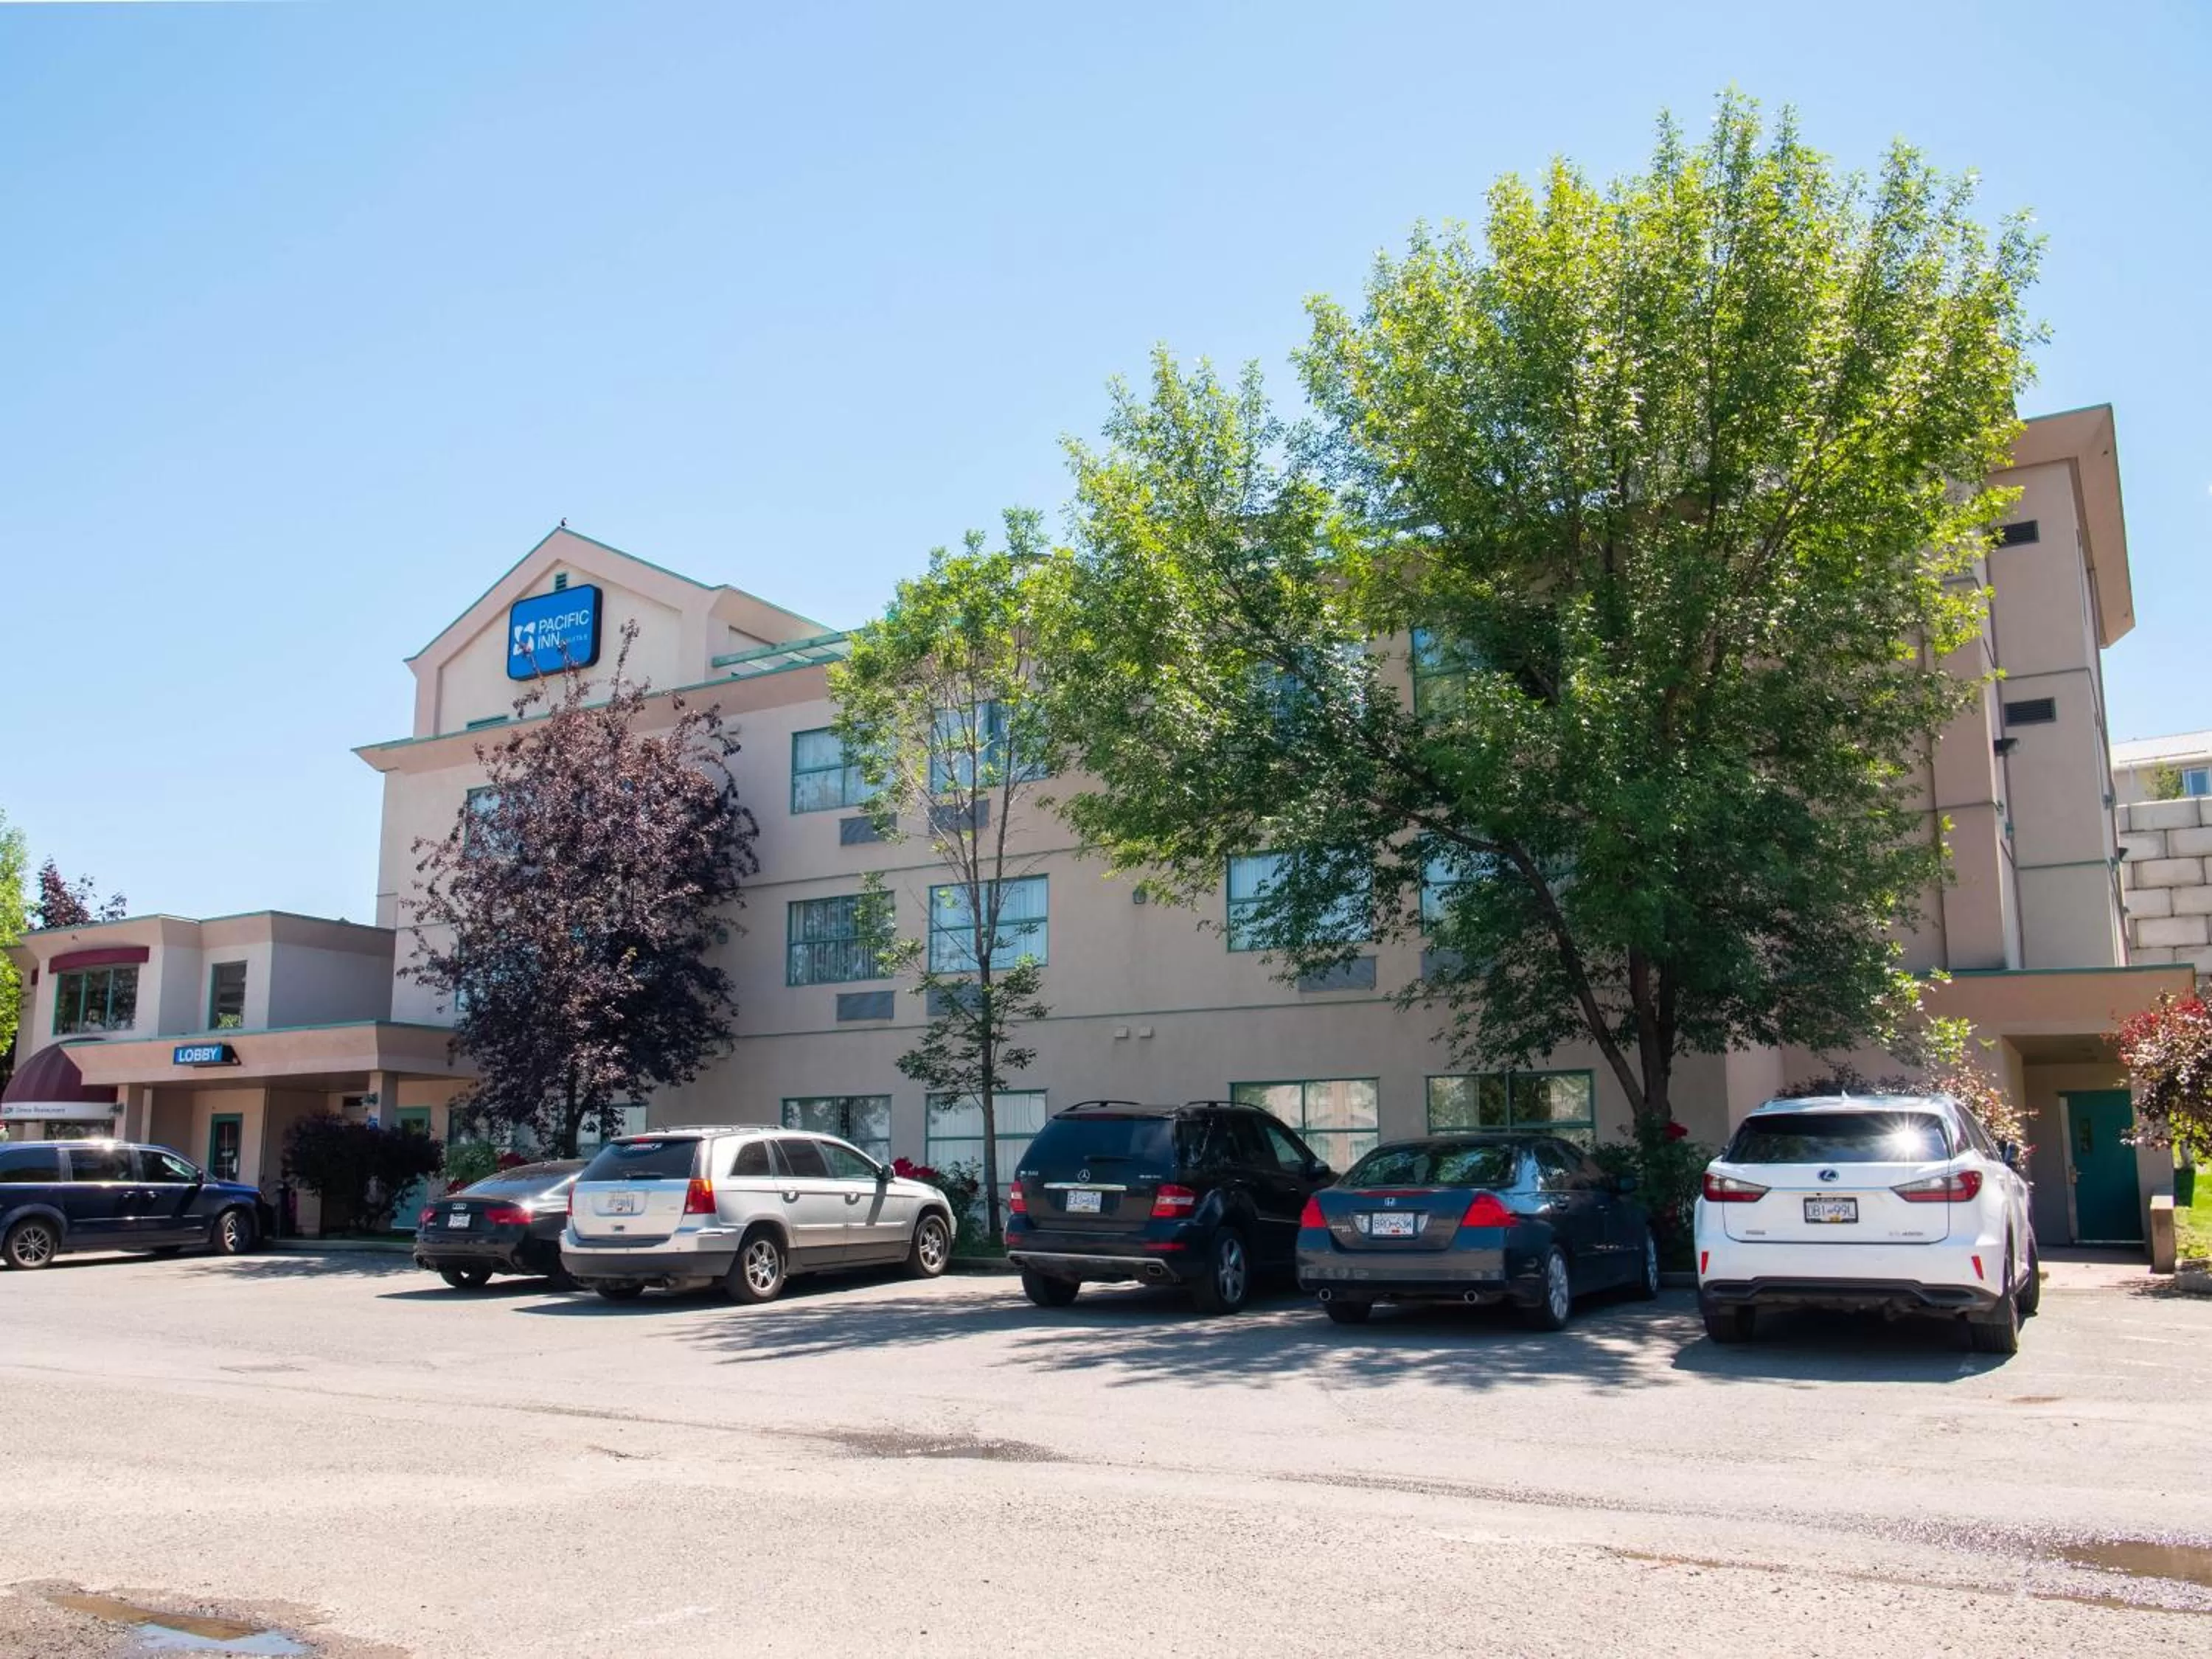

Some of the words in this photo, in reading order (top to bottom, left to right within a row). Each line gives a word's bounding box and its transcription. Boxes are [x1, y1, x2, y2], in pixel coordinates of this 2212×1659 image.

[538, 609, 590, 635] PACIFIC
[538, 630, 560, 650] INN
[178, 1047, 218, 1062] LOBBY
